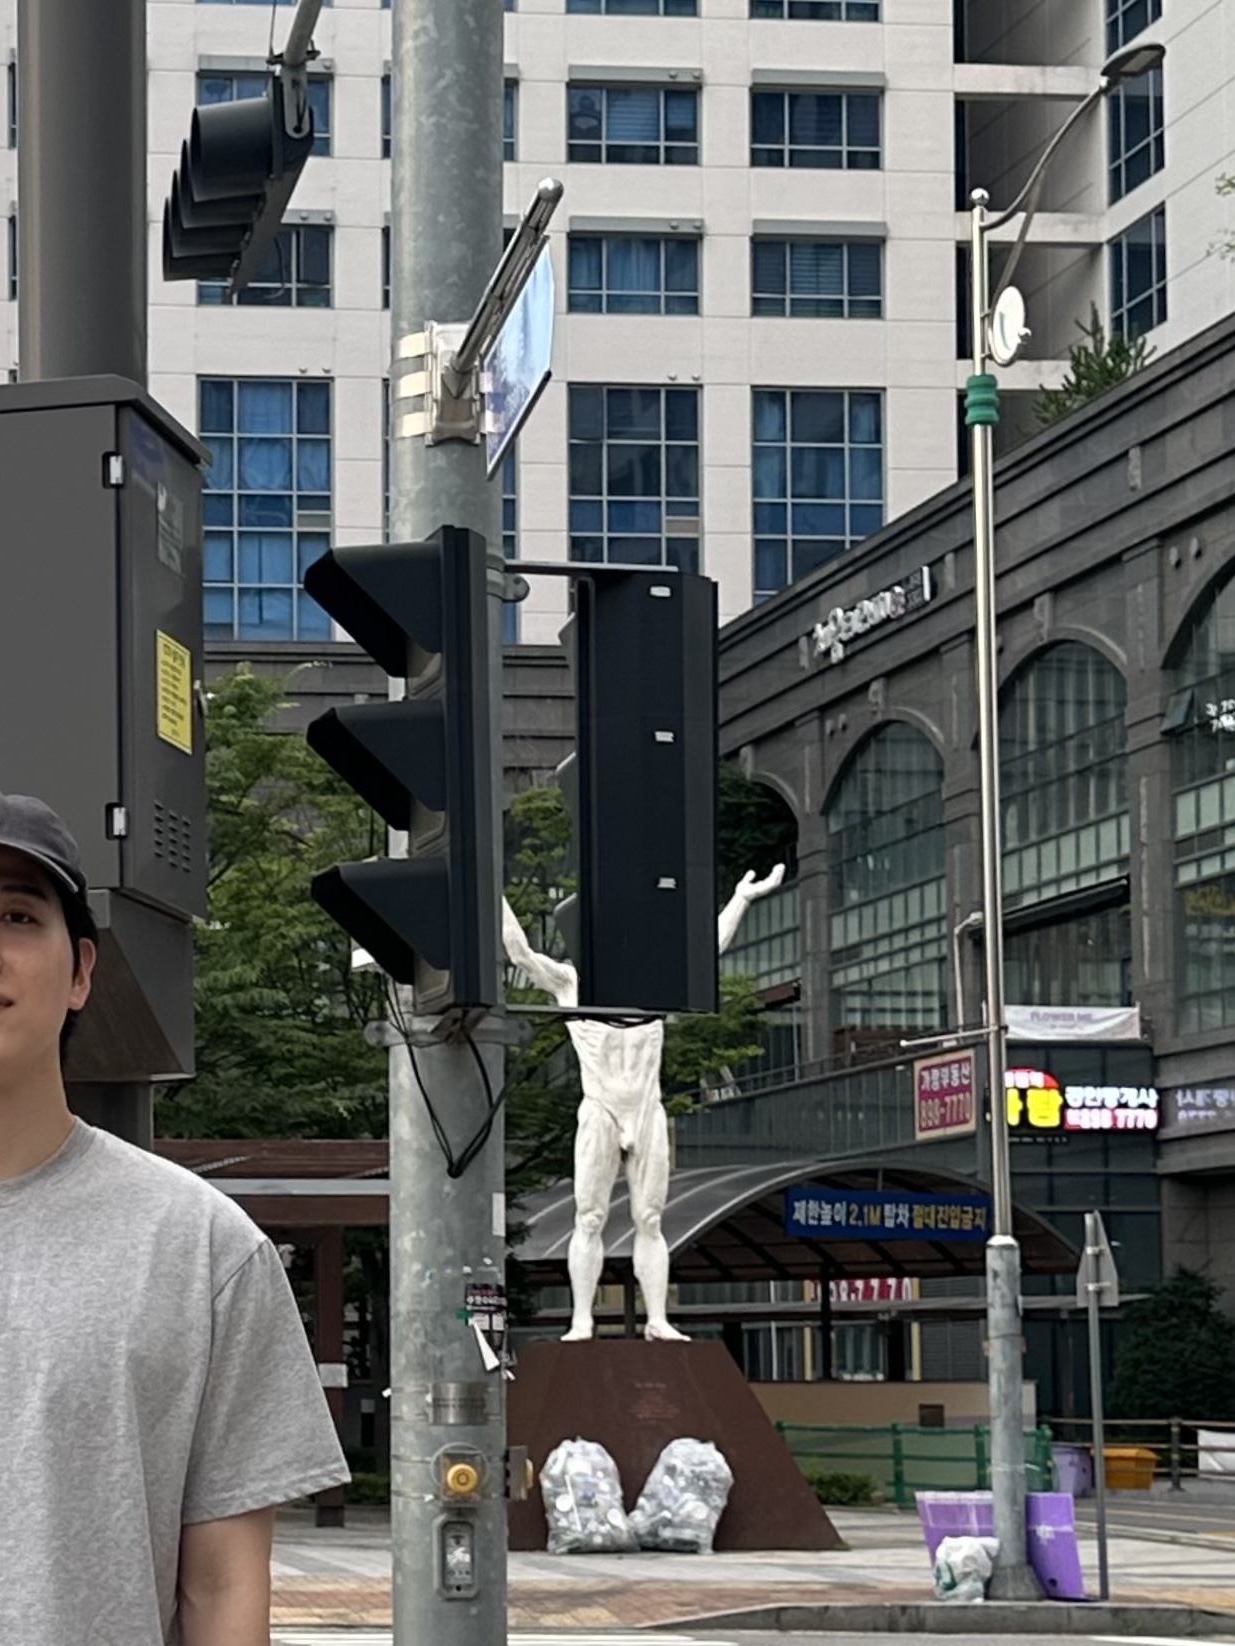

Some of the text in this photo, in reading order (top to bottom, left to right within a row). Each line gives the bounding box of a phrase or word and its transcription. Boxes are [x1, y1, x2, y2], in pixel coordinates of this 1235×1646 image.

[793, 1199, 847, 1227] 제한높이
[849, 1203, 881, 1227] 2.1M
[883, 1203, 910, 1229] 탑차
